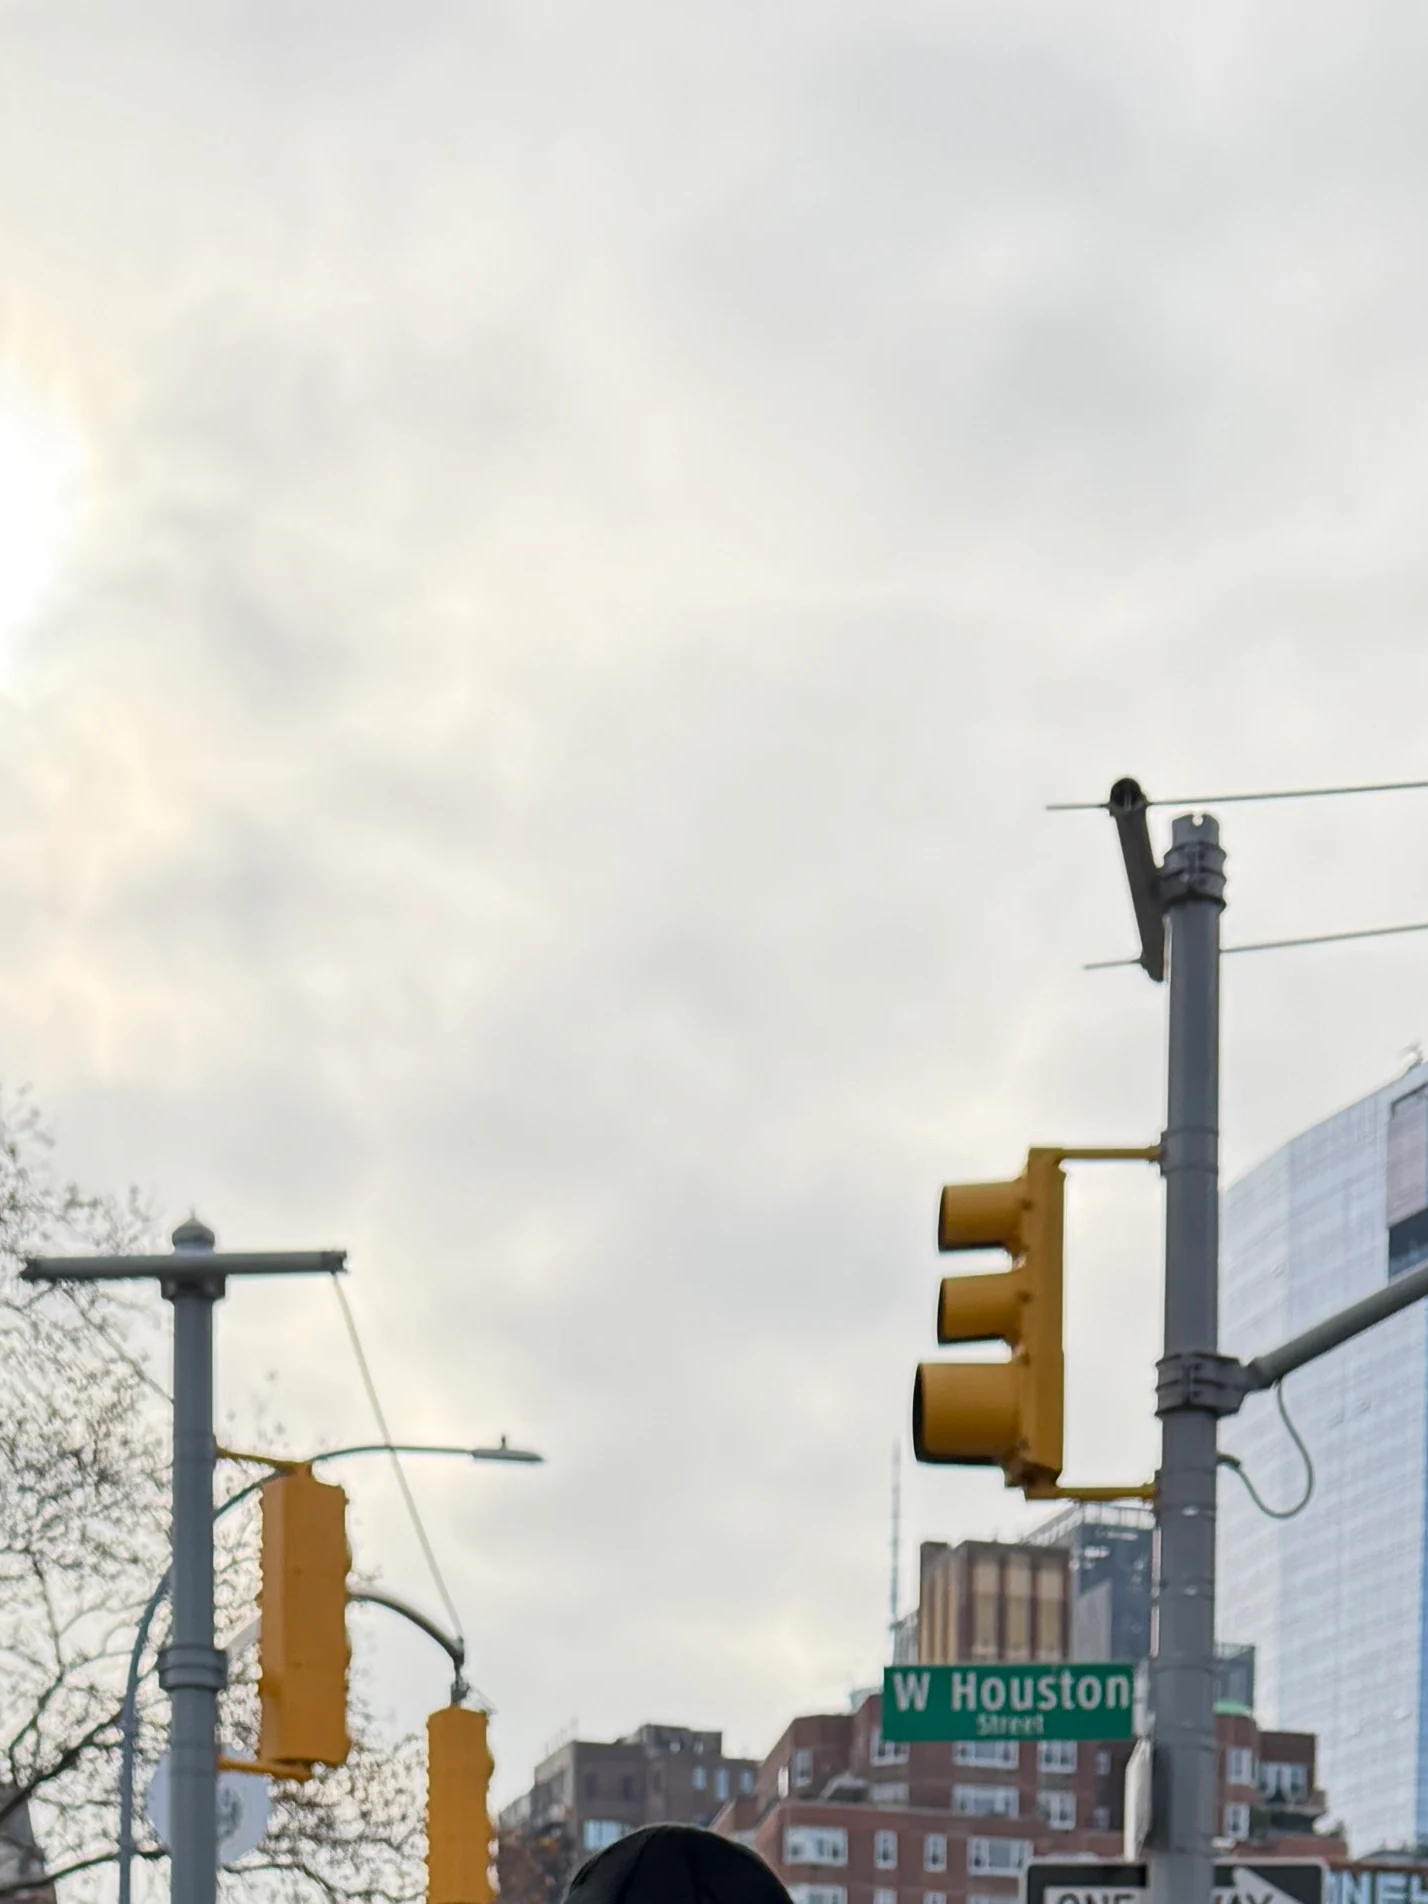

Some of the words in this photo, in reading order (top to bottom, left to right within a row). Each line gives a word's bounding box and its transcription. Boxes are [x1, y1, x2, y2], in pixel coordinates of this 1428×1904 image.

[892, 1672, 931, 1712] W
[951, 1669, 1131, 1712] Houston
[976, 1714, 1045, 1736] Street
